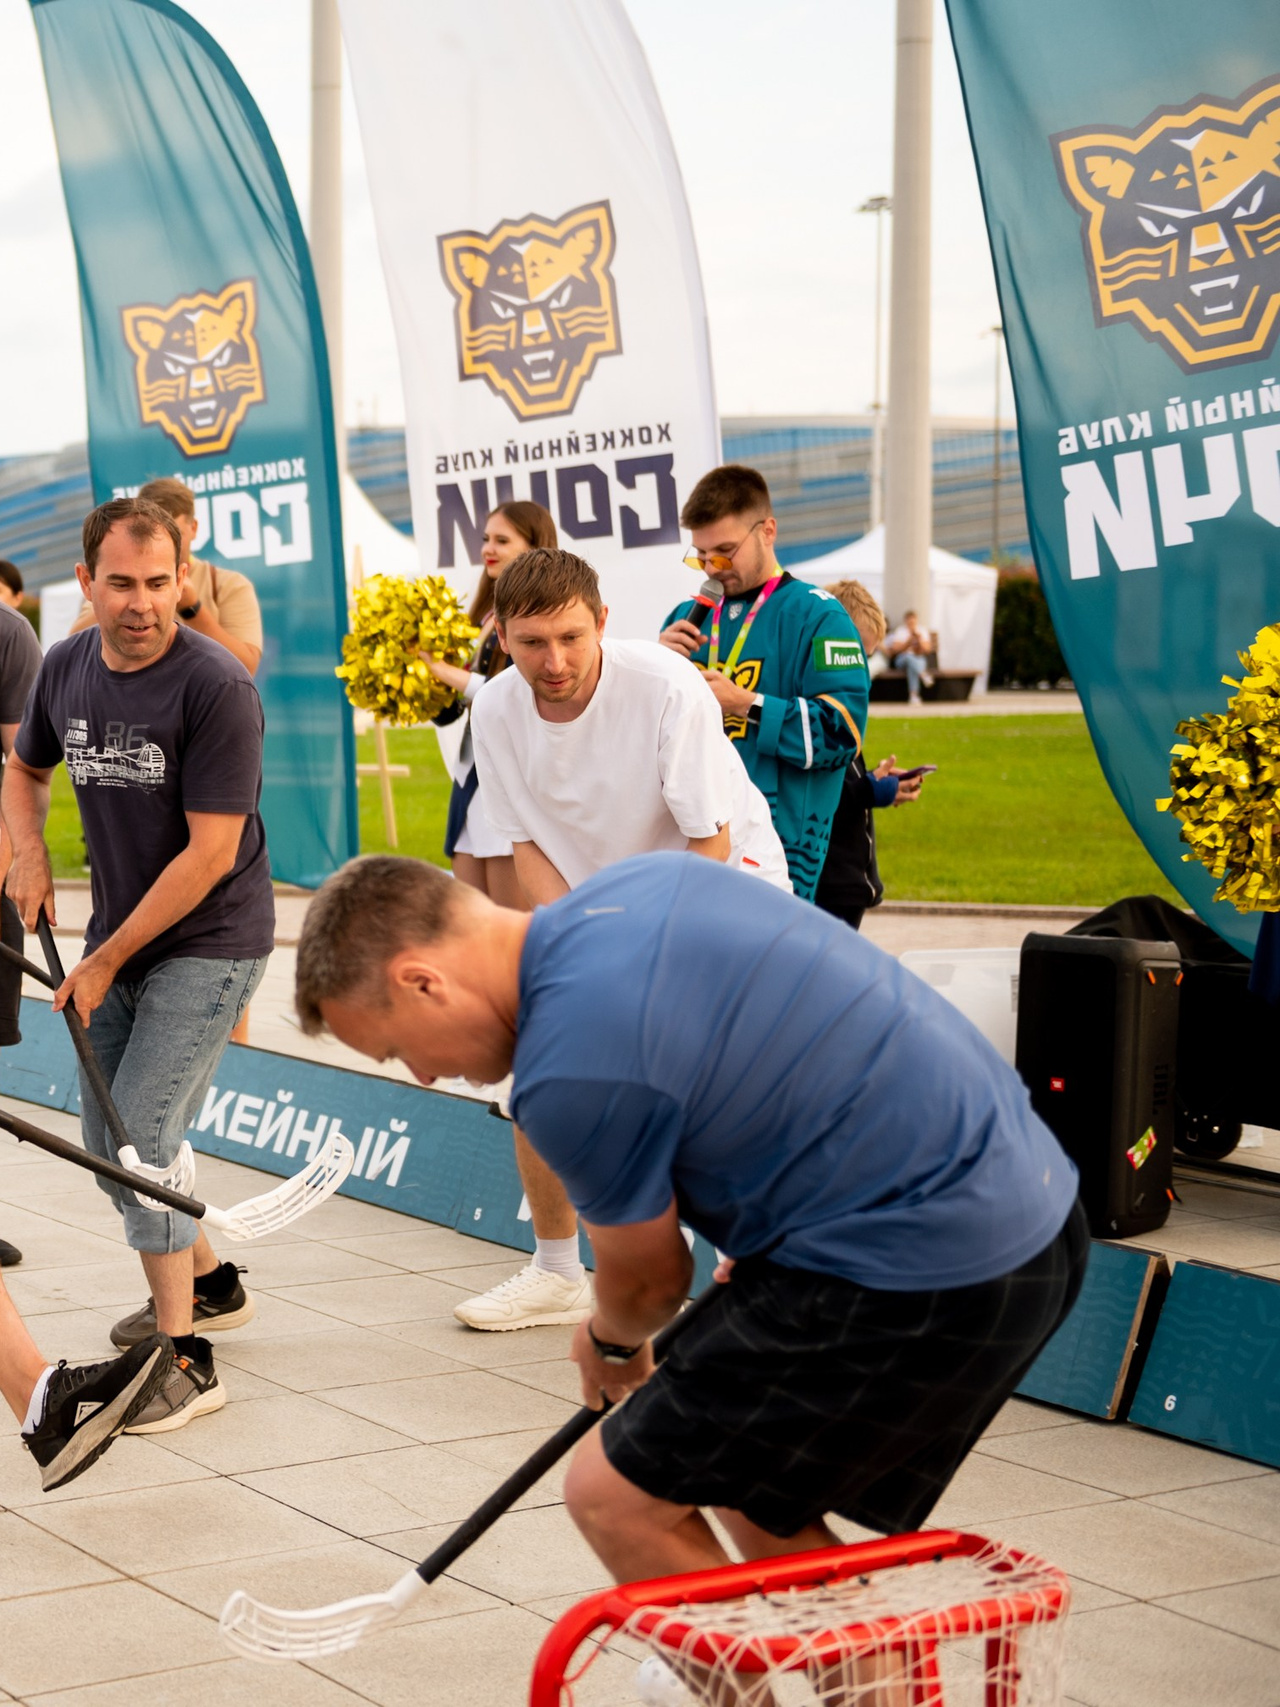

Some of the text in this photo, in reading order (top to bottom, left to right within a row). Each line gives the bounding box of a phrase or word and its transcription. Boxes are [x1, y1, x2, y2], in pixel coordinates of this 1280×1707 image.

[105, 721, 150, 758] 86
[189, 1086, 411, 1188] КЕЙНЫЙ
[473, 1207, 482, 1221] 5
[1164, 1394, 1177, 1411] 6
